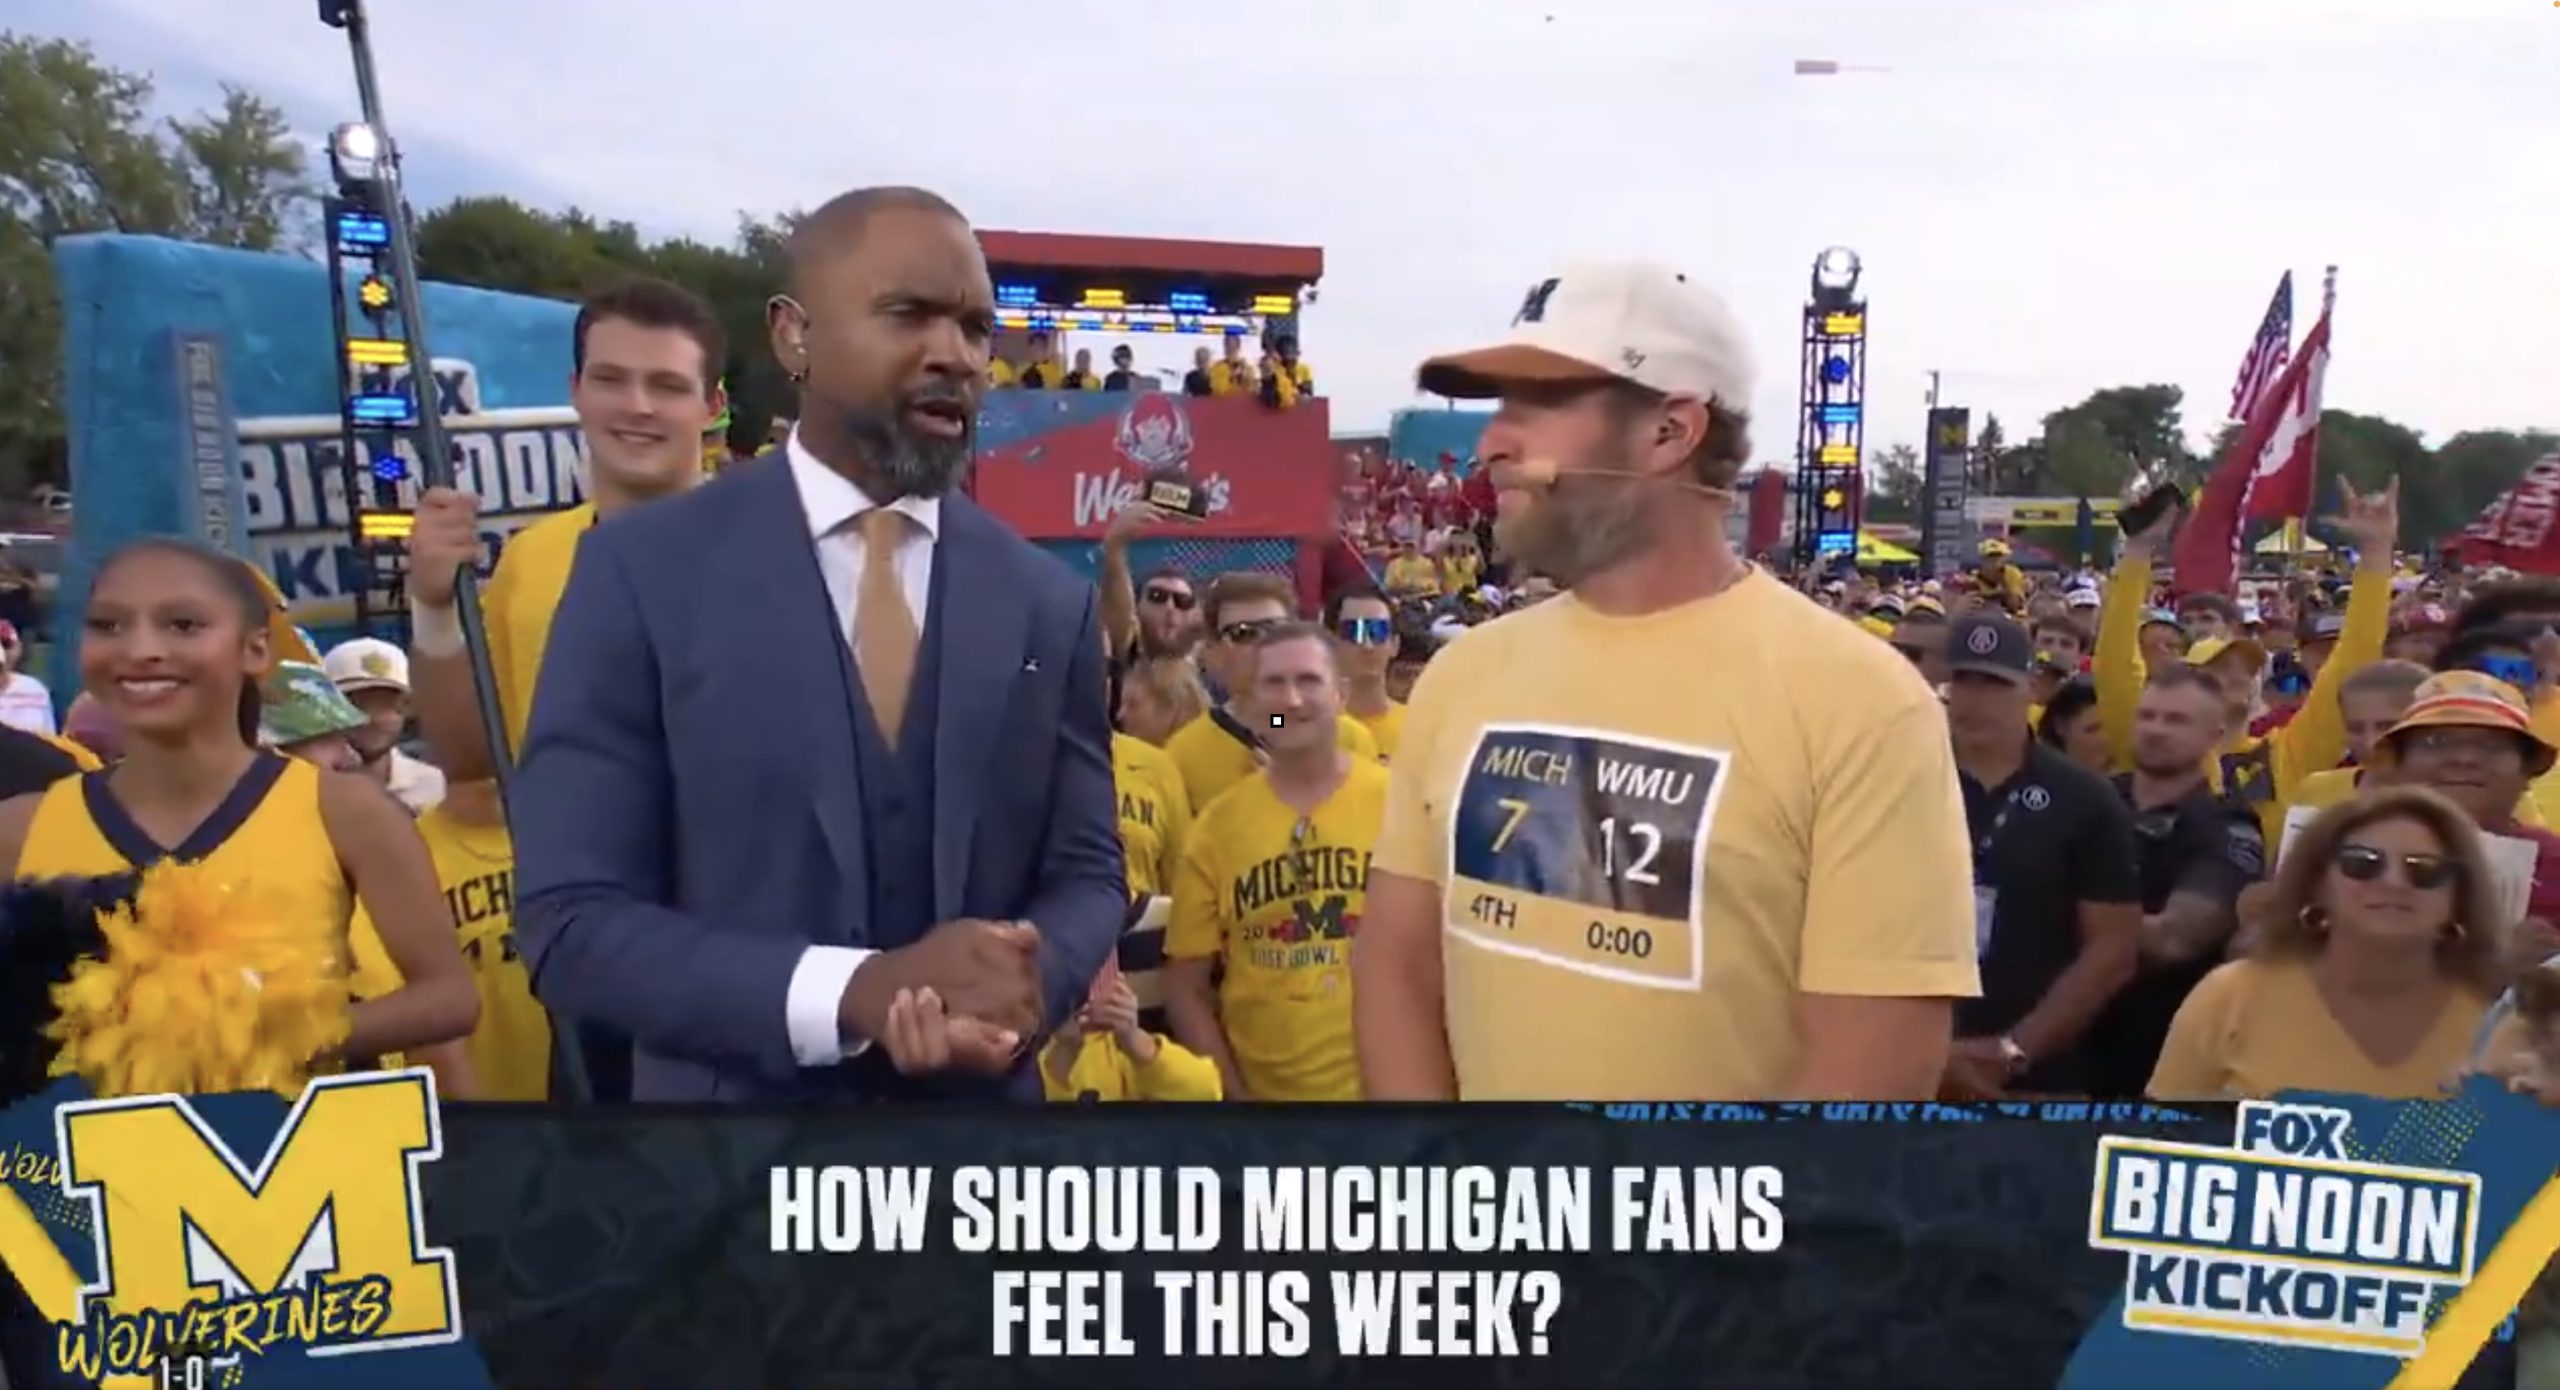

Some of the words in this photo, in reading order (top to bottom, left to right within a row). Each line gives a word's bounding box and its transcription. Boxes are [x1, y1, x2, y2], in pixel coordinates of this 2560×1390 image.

[1482, 746, 1573, 786] MICH
[1597, 758, 1694, 804] WMU
[1490, 798, 1530, 853] 7
[1600, 817, 1662, 885] 12
[1470, 893, 1517, 929] 4TH
[1587, 920, 1652, 958] 0:00
